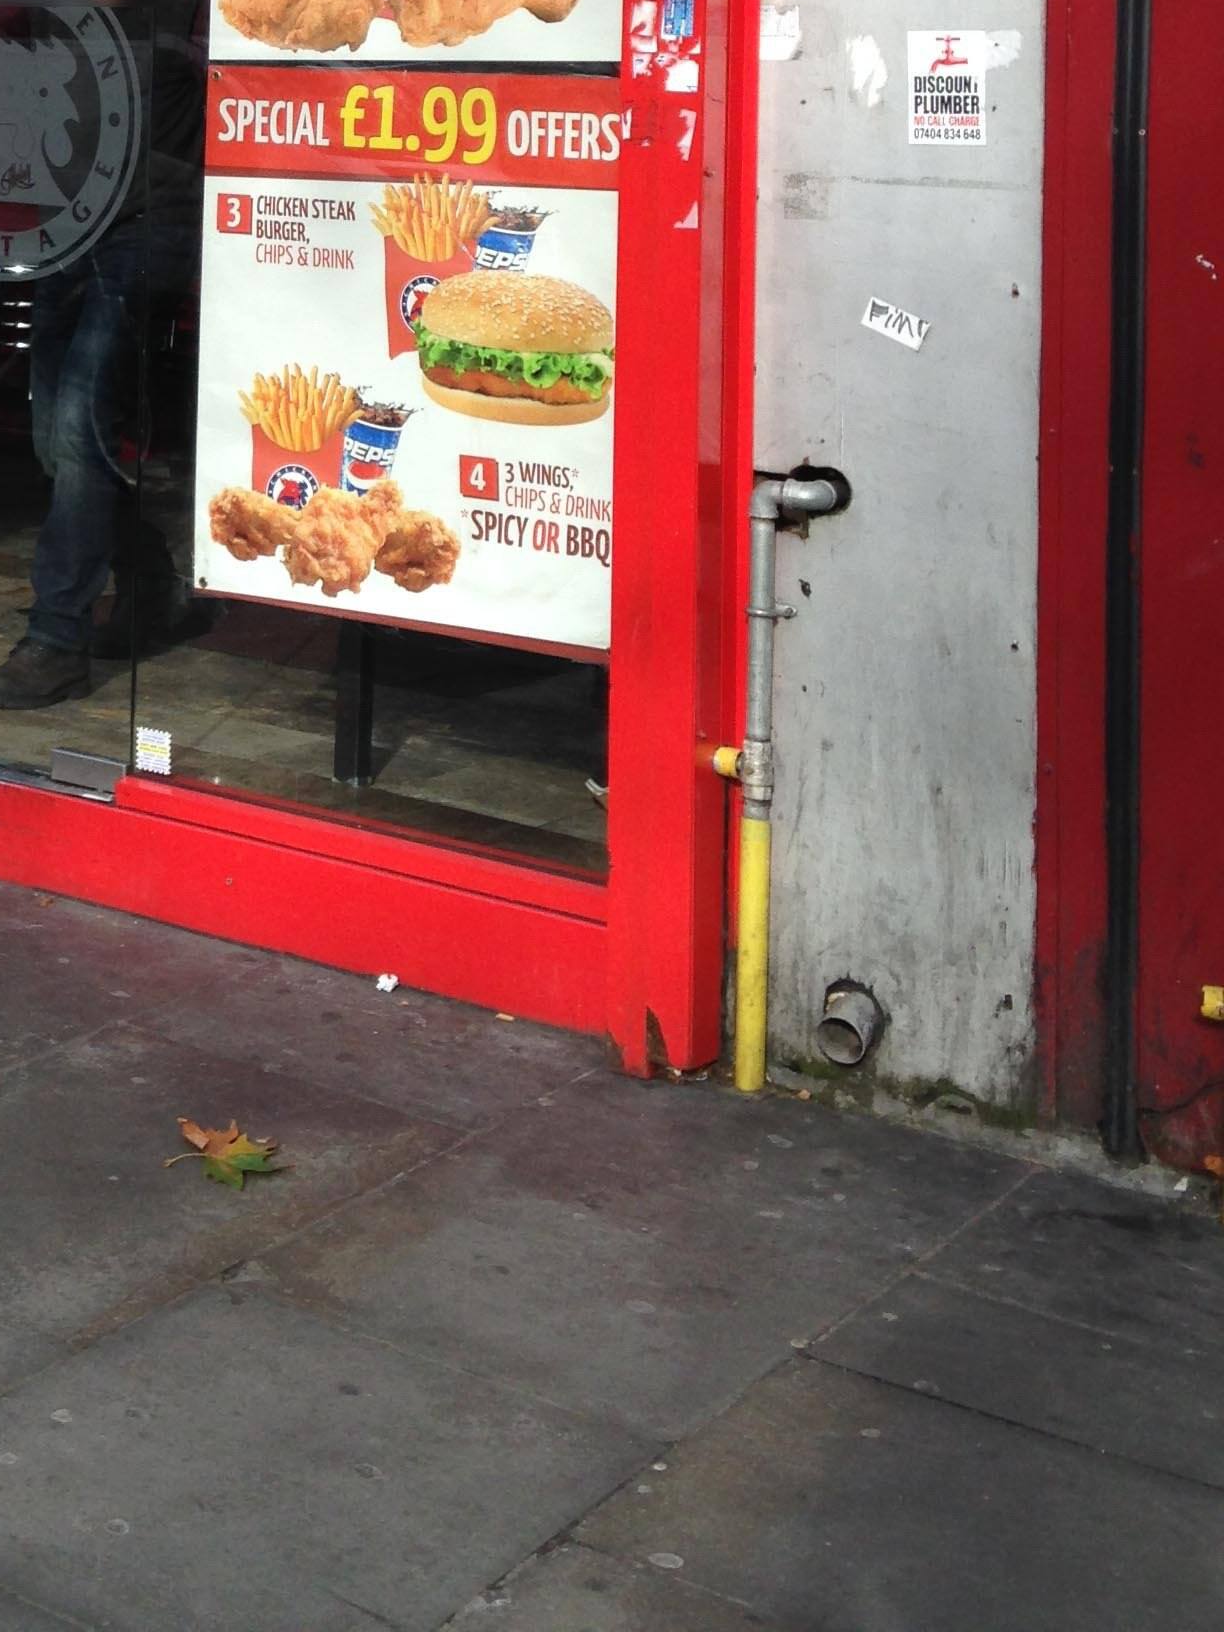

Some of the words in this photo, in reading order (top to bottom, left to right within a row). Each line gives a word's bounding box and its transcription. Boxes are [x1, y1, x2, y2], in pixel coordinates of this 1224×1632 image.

[914, 95, 980, 114] PLUMBER
[218, 97, 330, 147] SPECIAL
[340, 85, 498, 164] £1.99
[507, 109, 620, 161] OFFERS
[914, 116, 925, 126] NO
[928, 116, 945, 126] CALL
[948, 116, 980, 126] CHARGE
[914, 128, 941, 139] 07404
[944, 128, 961, 139] 834
[227, 197, 241, 228] 3
[257, 195, 309, 218] CHICKEN
[312, 199, 356, 221] STEAK
[256, 220, 310, 244] BURGER,
[256, 243, 294, 265] CHIPS
[298, 247, 309, 266] &
[313, 248, 355, 270] DRINK
[476, 245, 528, 271] EPS
[470, 463, 486, 491] 4
[505, 462, 515, 483] 3
[505, 486, 546, 512] CHIPS
[549, 492, 561, 514] &
[565, 494, 611, 522] DRINK
[532, 519, 559, 554] OR
[566, 524, 610, 568] BBQ
